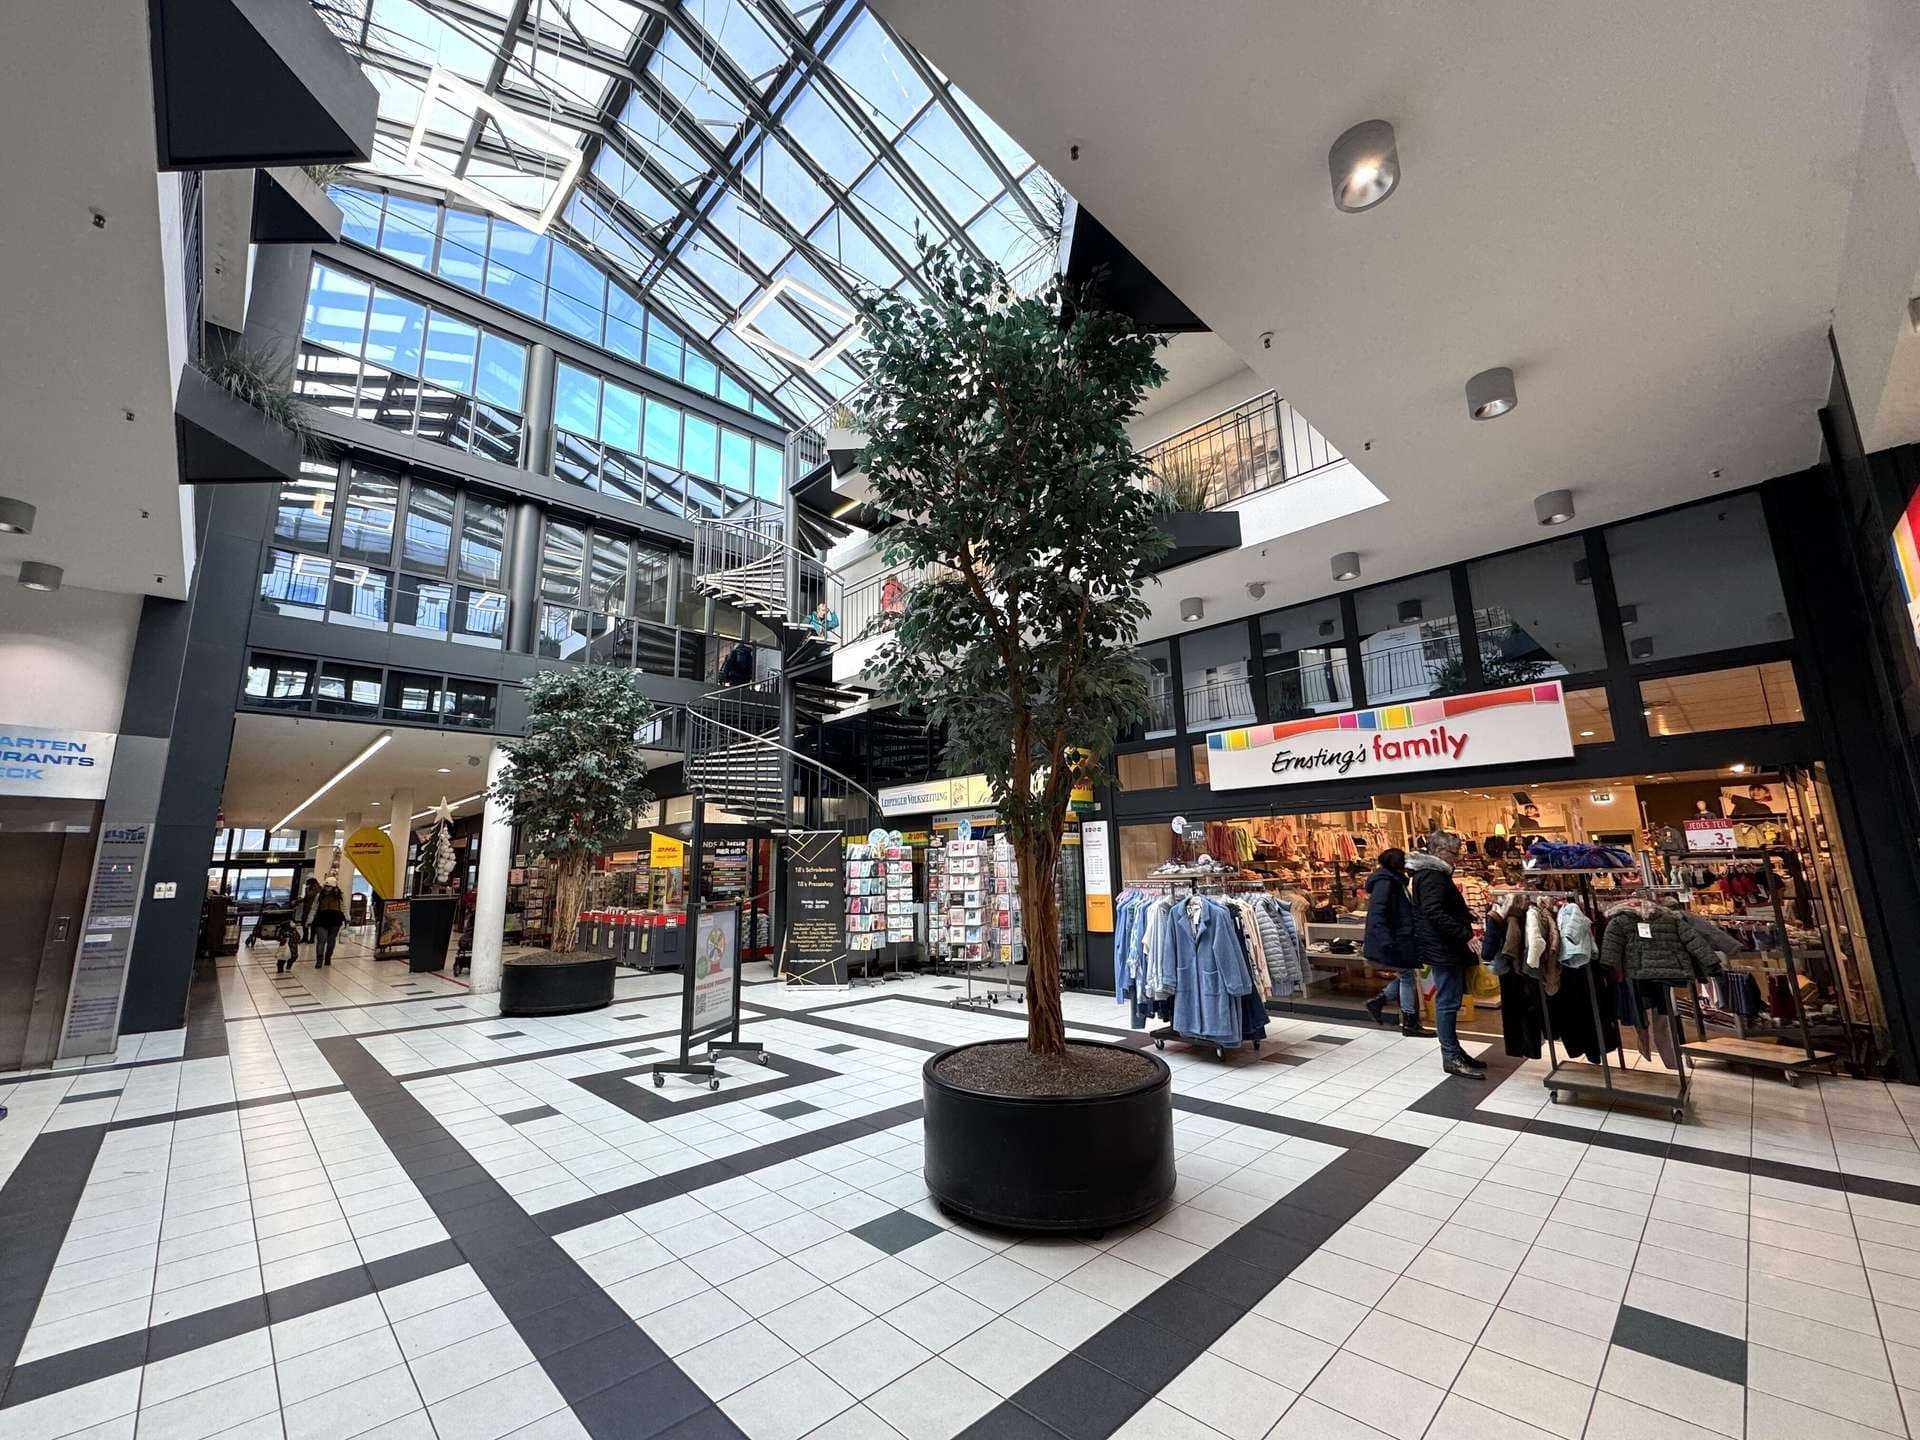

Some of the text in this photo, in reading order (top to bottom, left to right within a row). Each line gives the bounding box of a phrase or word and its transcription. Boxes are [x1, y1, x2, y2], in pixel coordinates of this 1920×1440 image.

[1271, 726, 1468, 774] Ernsting's family
[0, 751, 95, 767] RANTS
[1688, 820, 1729, 830] JEDES TEIL
